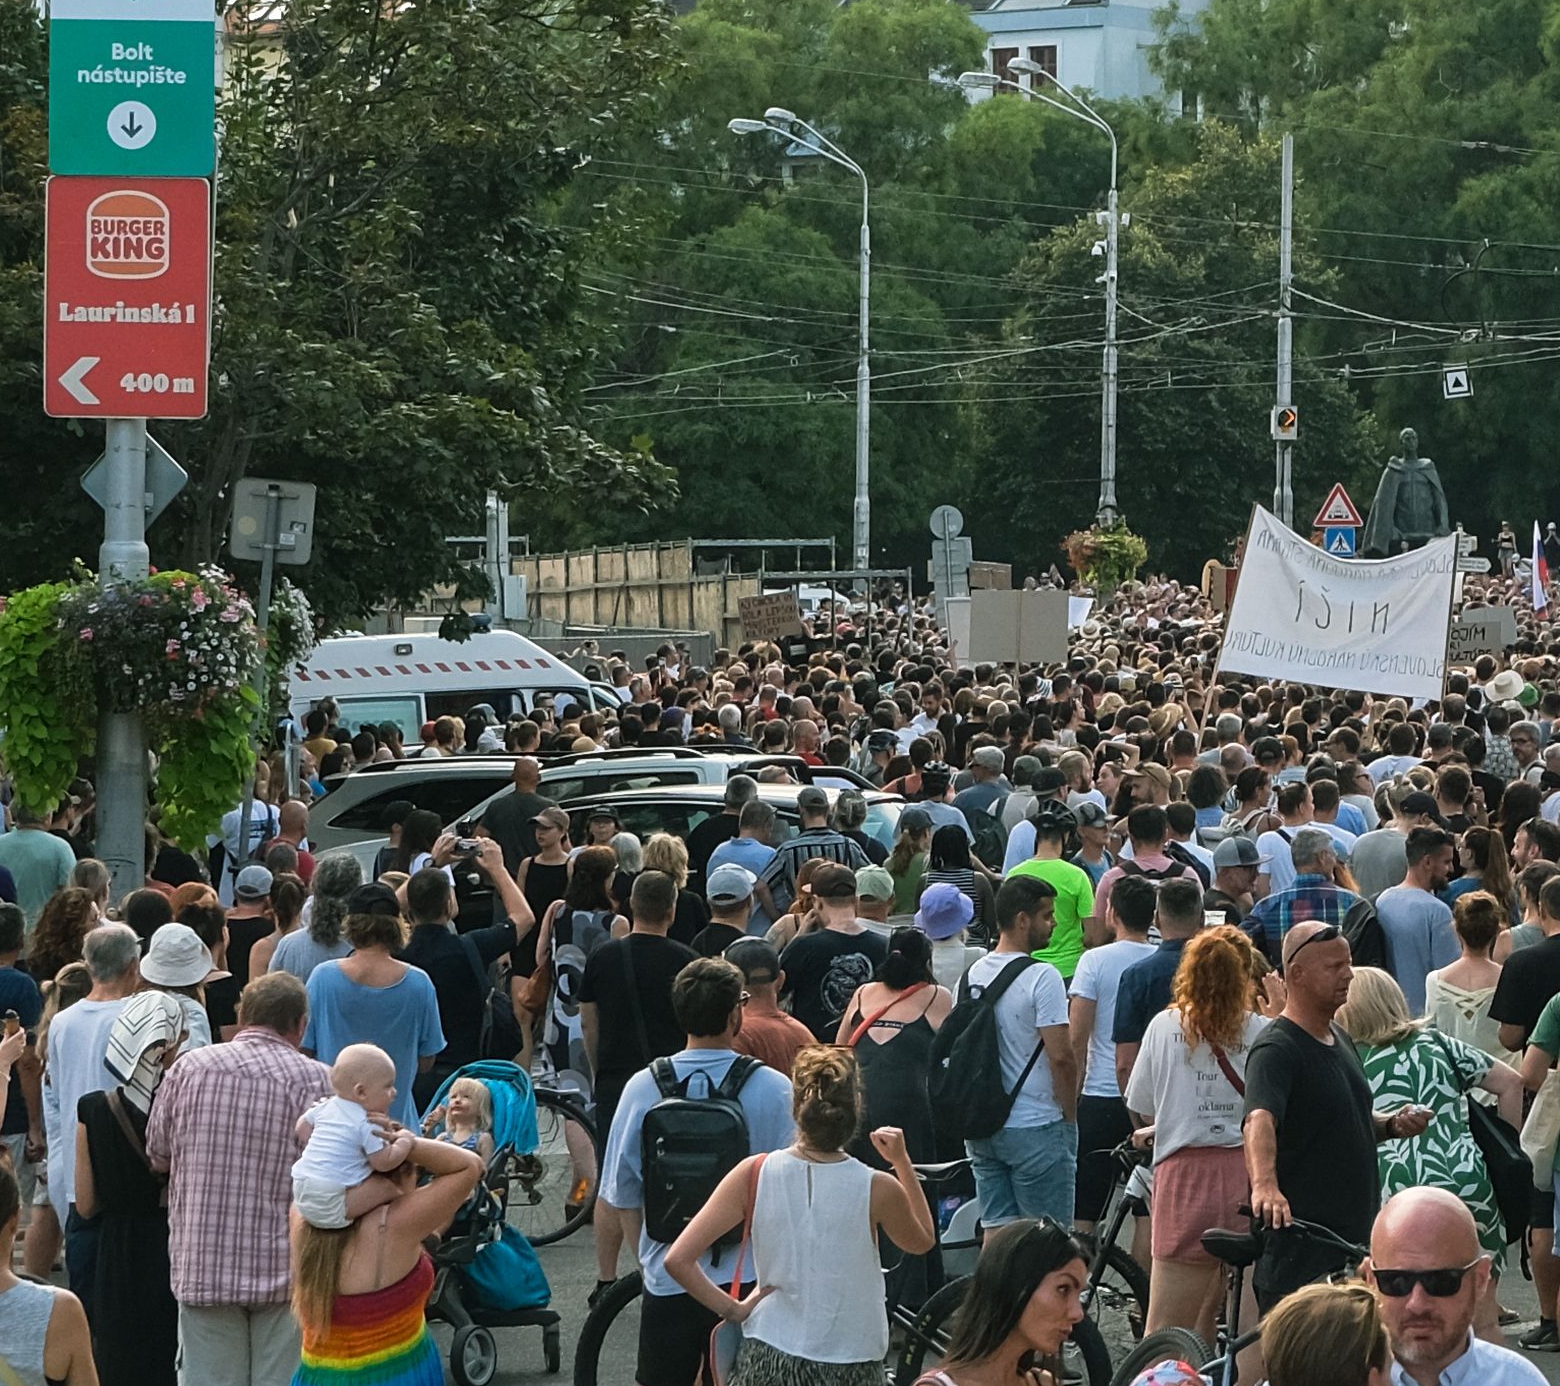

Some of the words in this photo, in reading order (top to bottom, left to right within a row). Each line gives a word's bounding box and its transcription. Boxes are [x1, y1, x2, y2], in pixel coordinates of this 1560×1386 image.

[112, 42, 153, 61] Bolt
[77, 64, 186, 85] nástupište
[90, 218, 165, 237] BURGER
[90, 236, 165, 261] KING
[59, 302, 183, 324] Laurinská
[120, 372, 169, 393] 400
[172, 377, 195, 393] m
[1450, 623, 1486, 641] OJÍM
[1196, 1071, 1219, 1081] Tour
[1198, 1101, 1235, 1111] oklama
